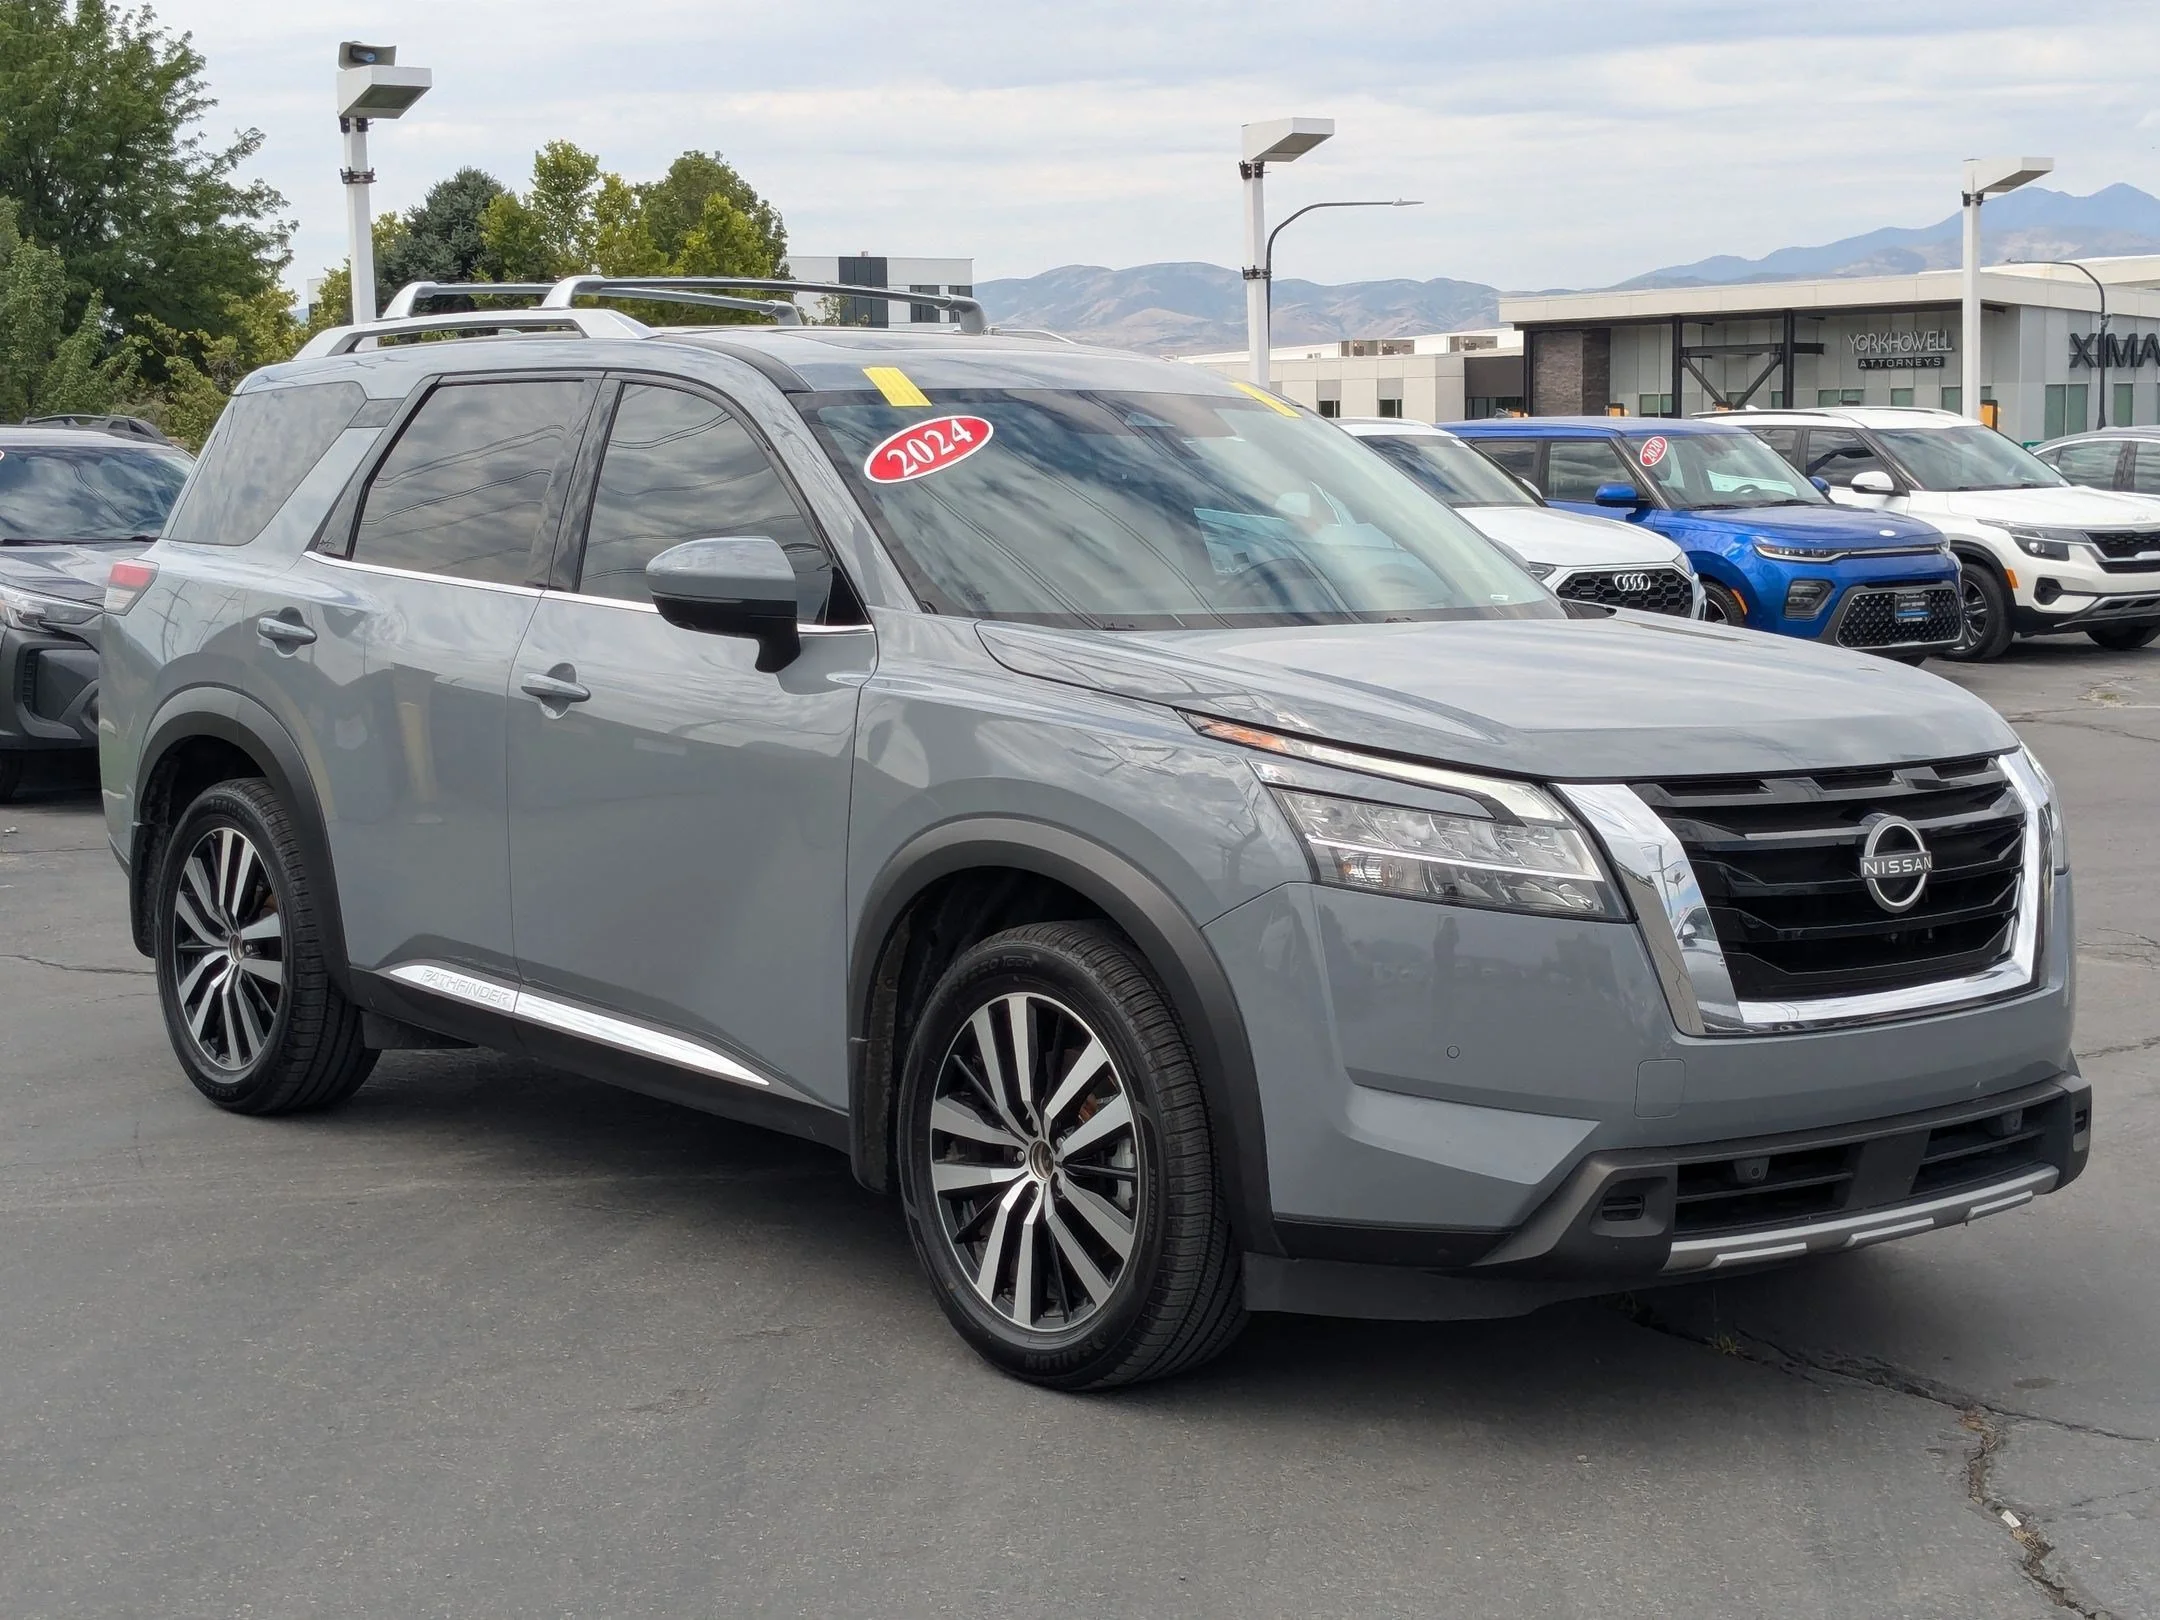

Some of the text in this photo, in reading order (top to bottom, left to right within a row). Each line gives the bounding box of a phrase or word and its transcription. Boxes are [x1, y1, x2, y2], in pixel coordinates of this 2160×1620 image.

[1858, 357, 1941, 369] ATTORNEYS
[887, 420, 974, 476] 2024
[1643, 439, 1664, 463] 2020
[1863, 856, 1932, 875] NISSAN
[421, 969, 512, 1003] PATHFINDER
